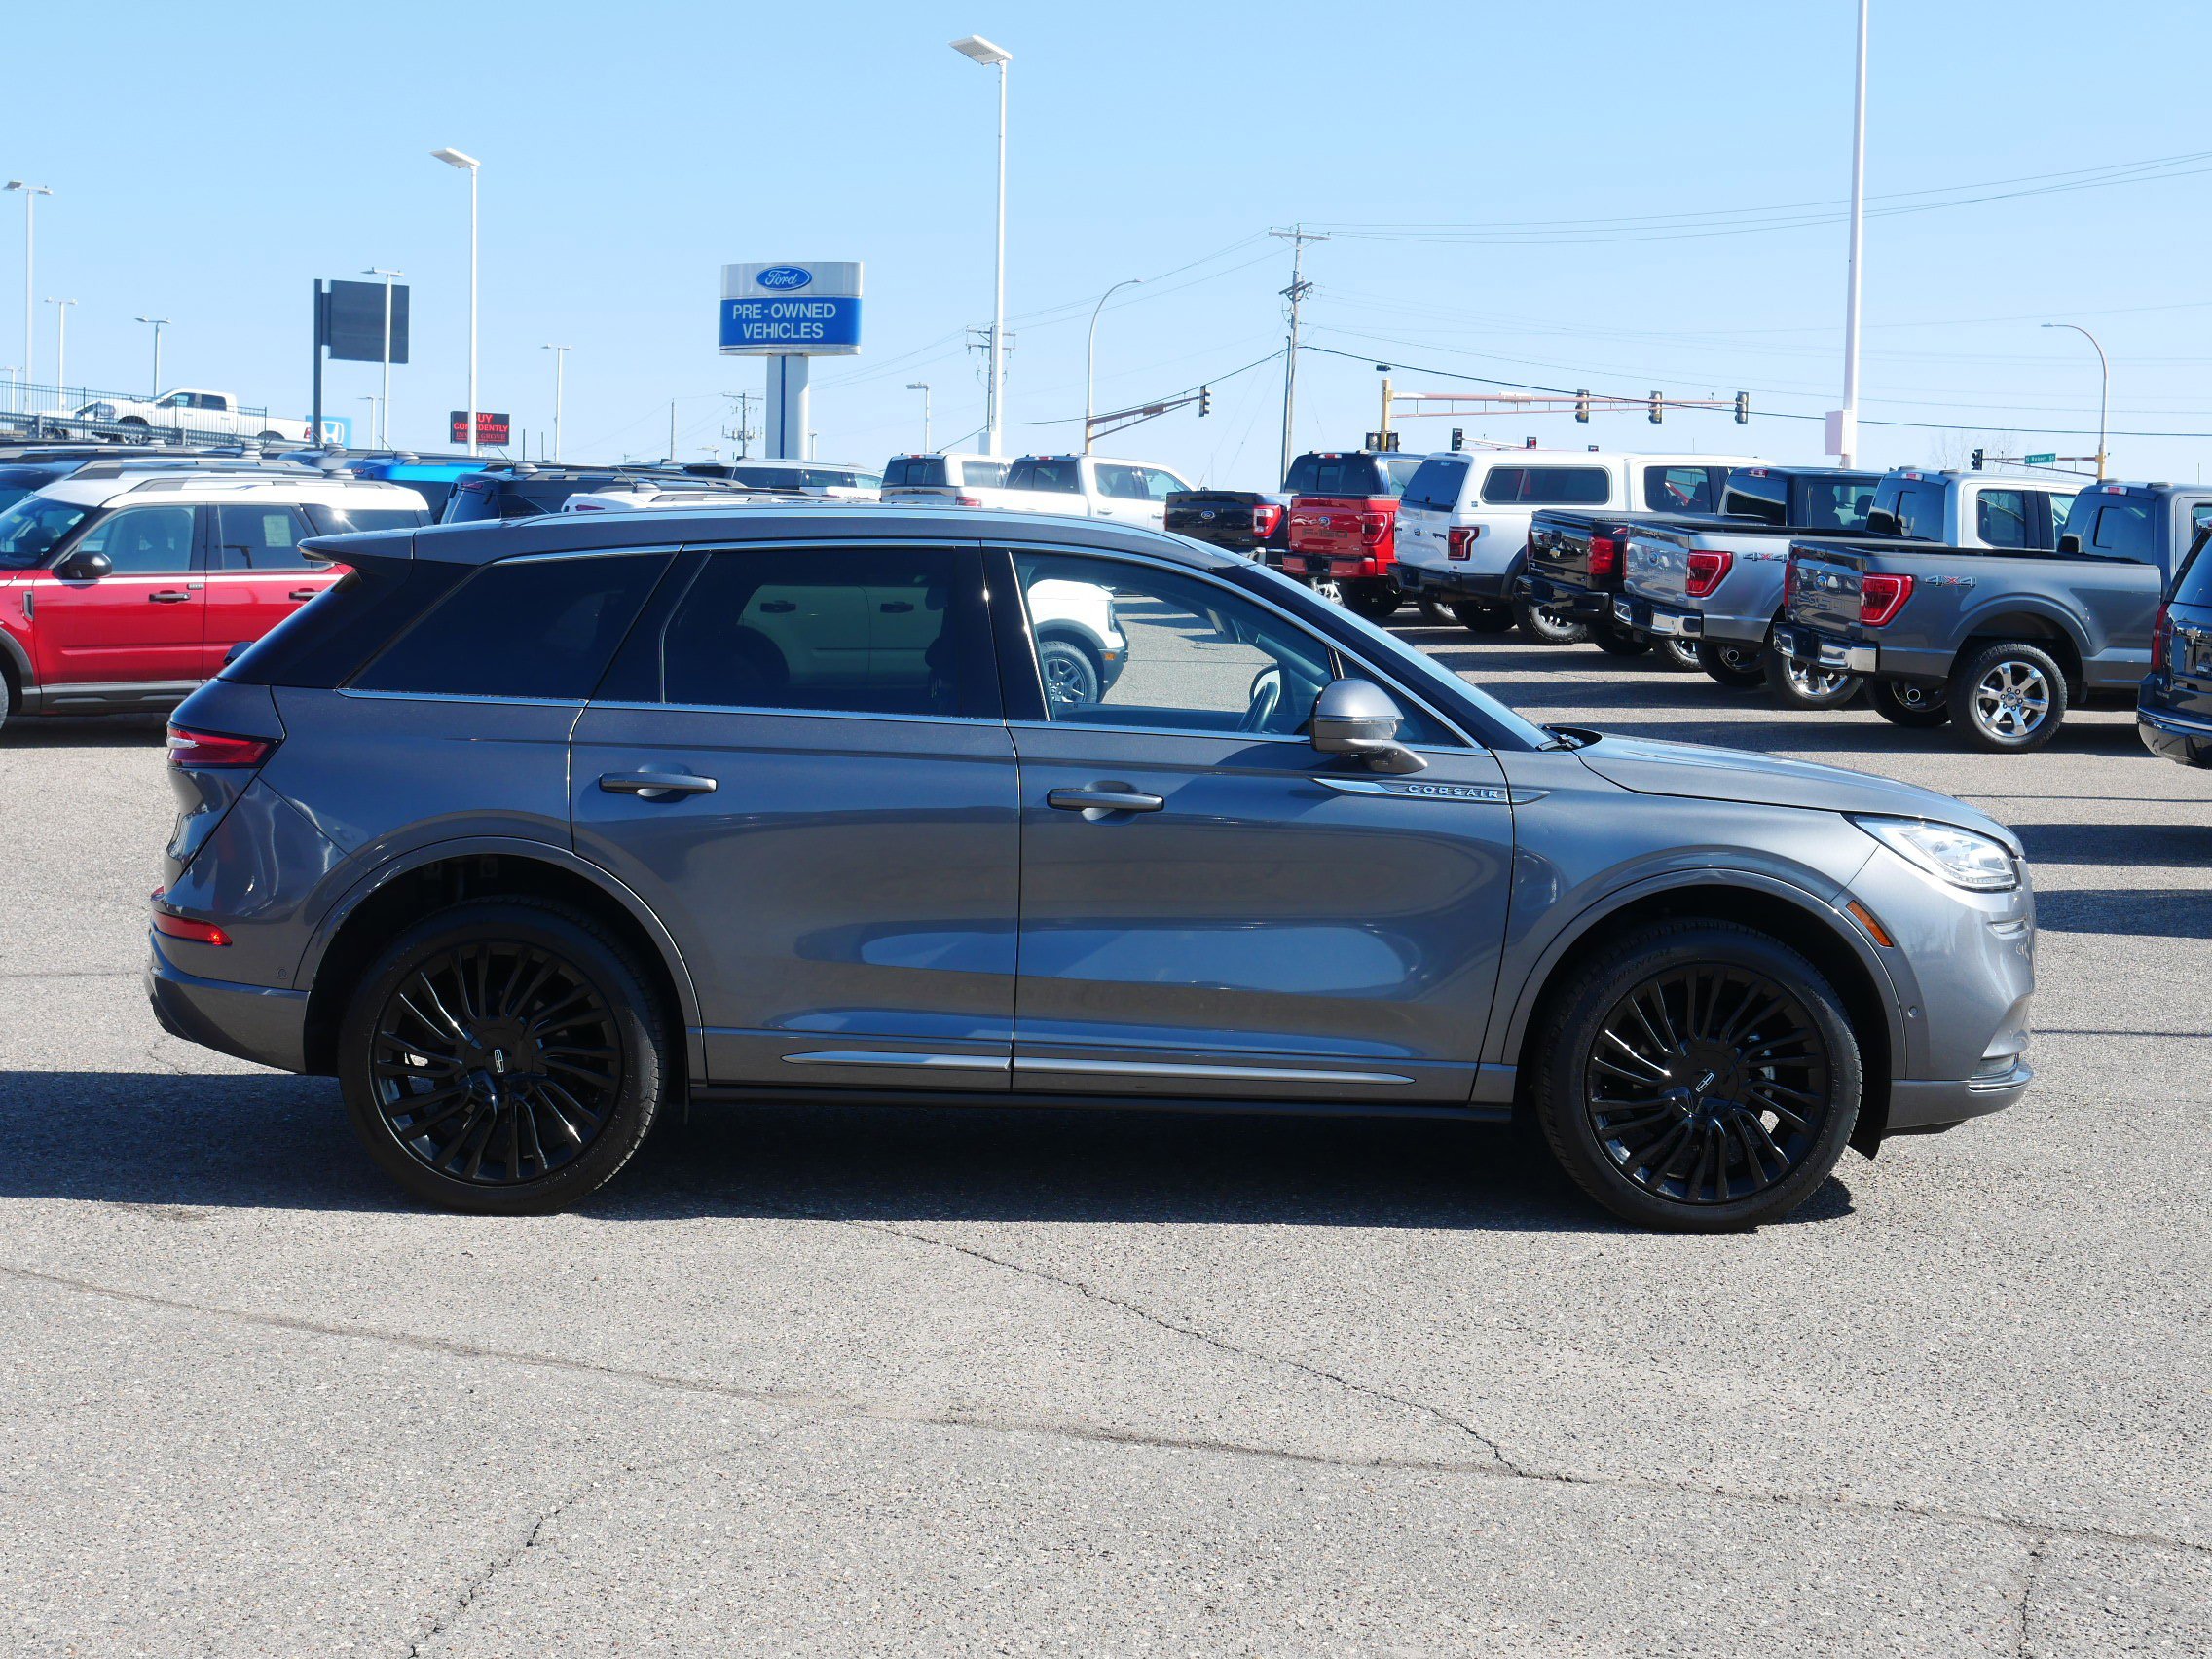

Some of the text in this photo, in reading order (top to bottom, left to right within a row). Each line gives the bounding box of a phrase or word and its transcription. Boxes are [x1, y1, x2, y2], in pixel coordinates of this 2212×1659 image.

[764, 270, 797, 285] Ford
[733, 303, 836, 319] PRE-OWNED
[742, 322, 824, 339] VEHICLES
[454, 422, 508, 432] CONDENTLY
[1408, 785, 1498, 798] CORSAIR
